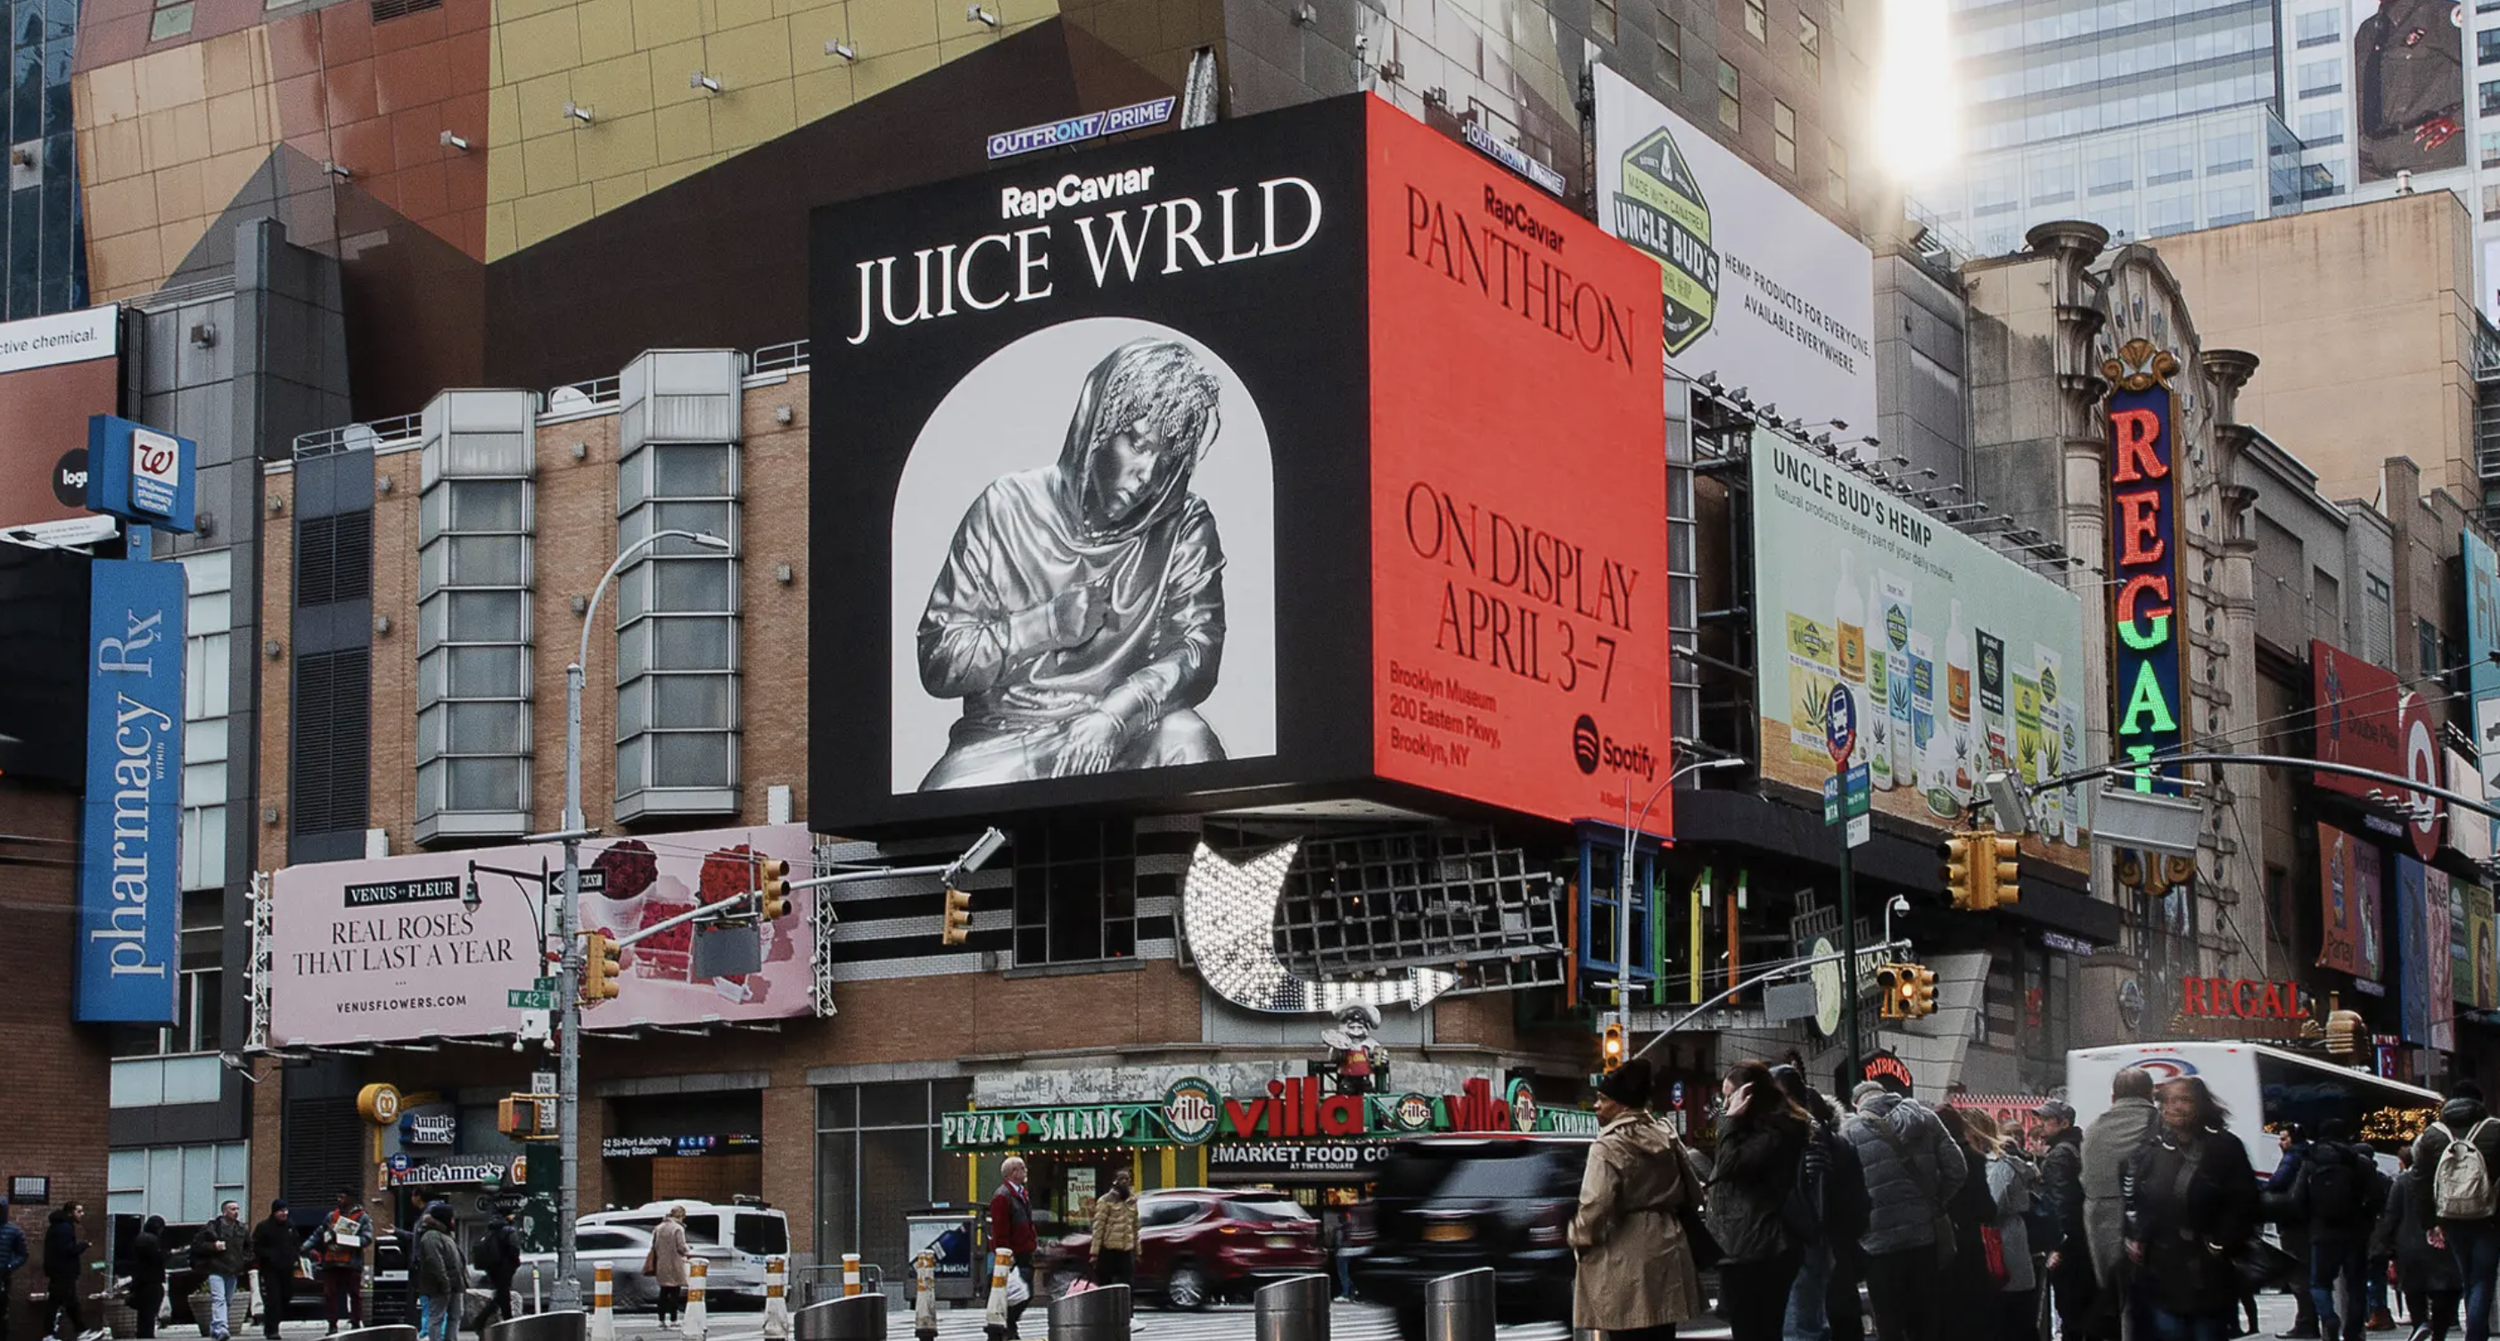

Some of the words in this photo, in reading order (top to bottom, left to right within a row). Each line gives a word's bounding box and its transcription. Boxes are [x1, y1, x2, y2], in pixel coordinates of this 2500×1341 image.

[992, 116, 1098, 154] OUTFRONT
[1110, 102, 1167, 129] PRIME
[1001, 165, 1155, 220] RapCaviar
[1628, 174, 1649, 197] MADE
[1484, 182, 1565, 255] RapCaviar
[847, 223, 1054, 346] JUICE
[1073, 176, 1323, 288] WRLD
[1615, 200, 1669, 254] UNCLE
[1672, 226, 1718, 293] BUD'S
[1404, 182, 1636, 374] PANTHEON
[1725, 252, 1751, 281] HEMP
[1754, 270, 1803, 315] PRODUCTS
[1804, 303, 1822, 329] FOR
[1744, 293, 1795, 339] AVAILABLE
[33, 327, 97, 350] chemical.
[1774, 448, 1833, 500] UNCLE
[1837, 480, 1885, 526] BUD'S
[1888, 506, 1932, 548] HEMP
[1774, 483, 1804, 509] Natural
[1805, 500, 1838, 527] products
[1839, 514, 1851, 531] for
[1851, 522, 1872, 545] every
[1872, 534, 1886, 551] part
[1887, 540, 1896, 554] of
[1896, 545, 1912, 560] your
[1912, 552, 1930, 573] daily
[1405, 481, 1478, 577] ON
[1488, 510, 1640, 633] DISPLAY
[98, 608, 162, 678] Rx
[1435, 580, 1550, 684] APRIL
[1390, 660, 1444, 700] Brooklyn
[1446, 676, 1498, 713] Museum
[1390, 692, 1418, 722] 200
[1419, 701, 1465, 736] Eastern
[1466, 715, 1501, 749] Pkwy,
[155, 741, 166, 781] WITHIN
[1391, 726, 1448, 767] Brooklyn,
[1450, 741, 1470, 767] NY
[1604, 735, 1656, 782] Spotify
[91, 692, 171, 979] pharmacy
[351, 886, 397, 903] VENUS
[408, 882, 454, 899] FLEUR
[331, 918, 392, 944] REAL
[398, 912, 474, 940] ROSES
[293, 949, 359, 976] THAT
[363, 944, 421, 972] LAST
[426, 944, 443, 967] A
[450, 938, 513, 965] YEAR
[336, 995, 467, 1013] VENUSFLOWERS.COM
[510, 992, 520, 1006] W
[524, 992, 540, 1007] 42
[2182, 976, 2309, 1018] REGAL
[412, 1114, 456, 1130] Auntie
[1164, 1099, 1217, 1122] villa
[1223, 1076, 1364, 1138] villa
[1397, 1106, 1431, 1120] villa
[1443, 1077, 1511, 1132] villa
[1514, 1100, 1537, 1122] villa
[603, 1139, 611, 1148] 42
[613, 1137, 637, 1147] St-Port
[639, 1136, 672, 1147] Authority
[943, 1114, 1006, 1145] PIZZA
[1039, 1110, 1125, 1142] SALADS
[438, 1162, 505, 1181] Anne's
[603, 1147, 630, 1157] Subway
[632, 1146, 657, 1156] Station
[1219, 1146, 1300, 1163] MARKET
[1306, 1146, 1359, 1163] FOOD
[1325, 1162, 1354, 1170] SQUARE
